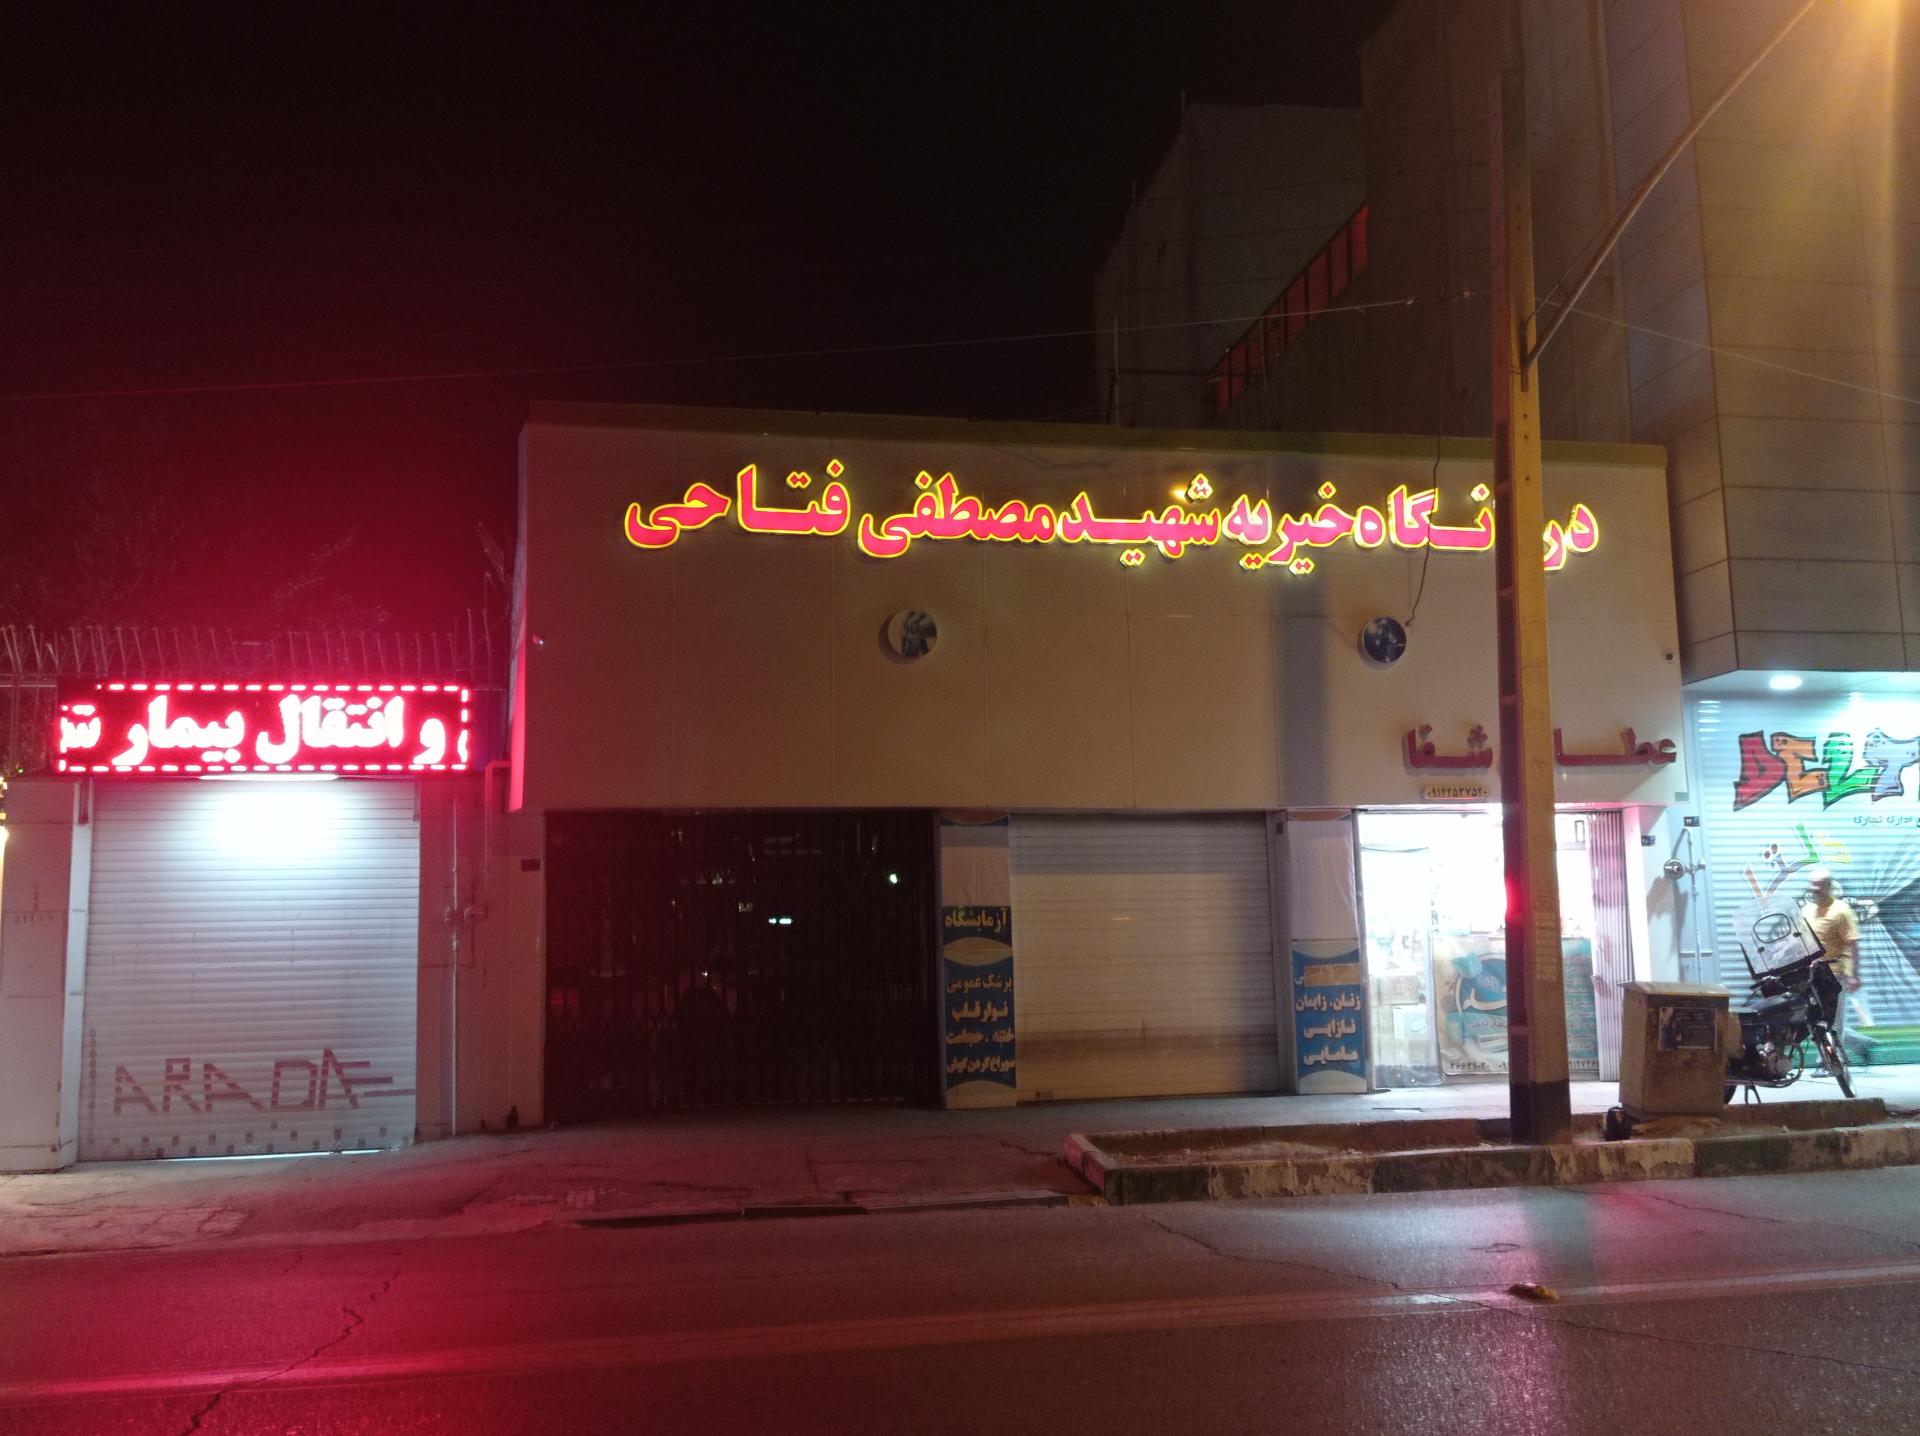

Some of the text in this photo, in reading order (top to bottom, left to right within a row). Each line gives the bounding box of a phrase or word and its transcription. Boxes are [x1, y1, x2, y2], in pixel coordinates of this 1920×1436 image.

[624, 459, 1599, 574] درنگاه خیریه شهید مصطفی فتاحی
[111, 694, 246, 767] بیمار
[255, 694, 405, 765] انتقال
[413, 717, 447, 766] و
[944, 906, 1009, 933] آزمایشگاه
